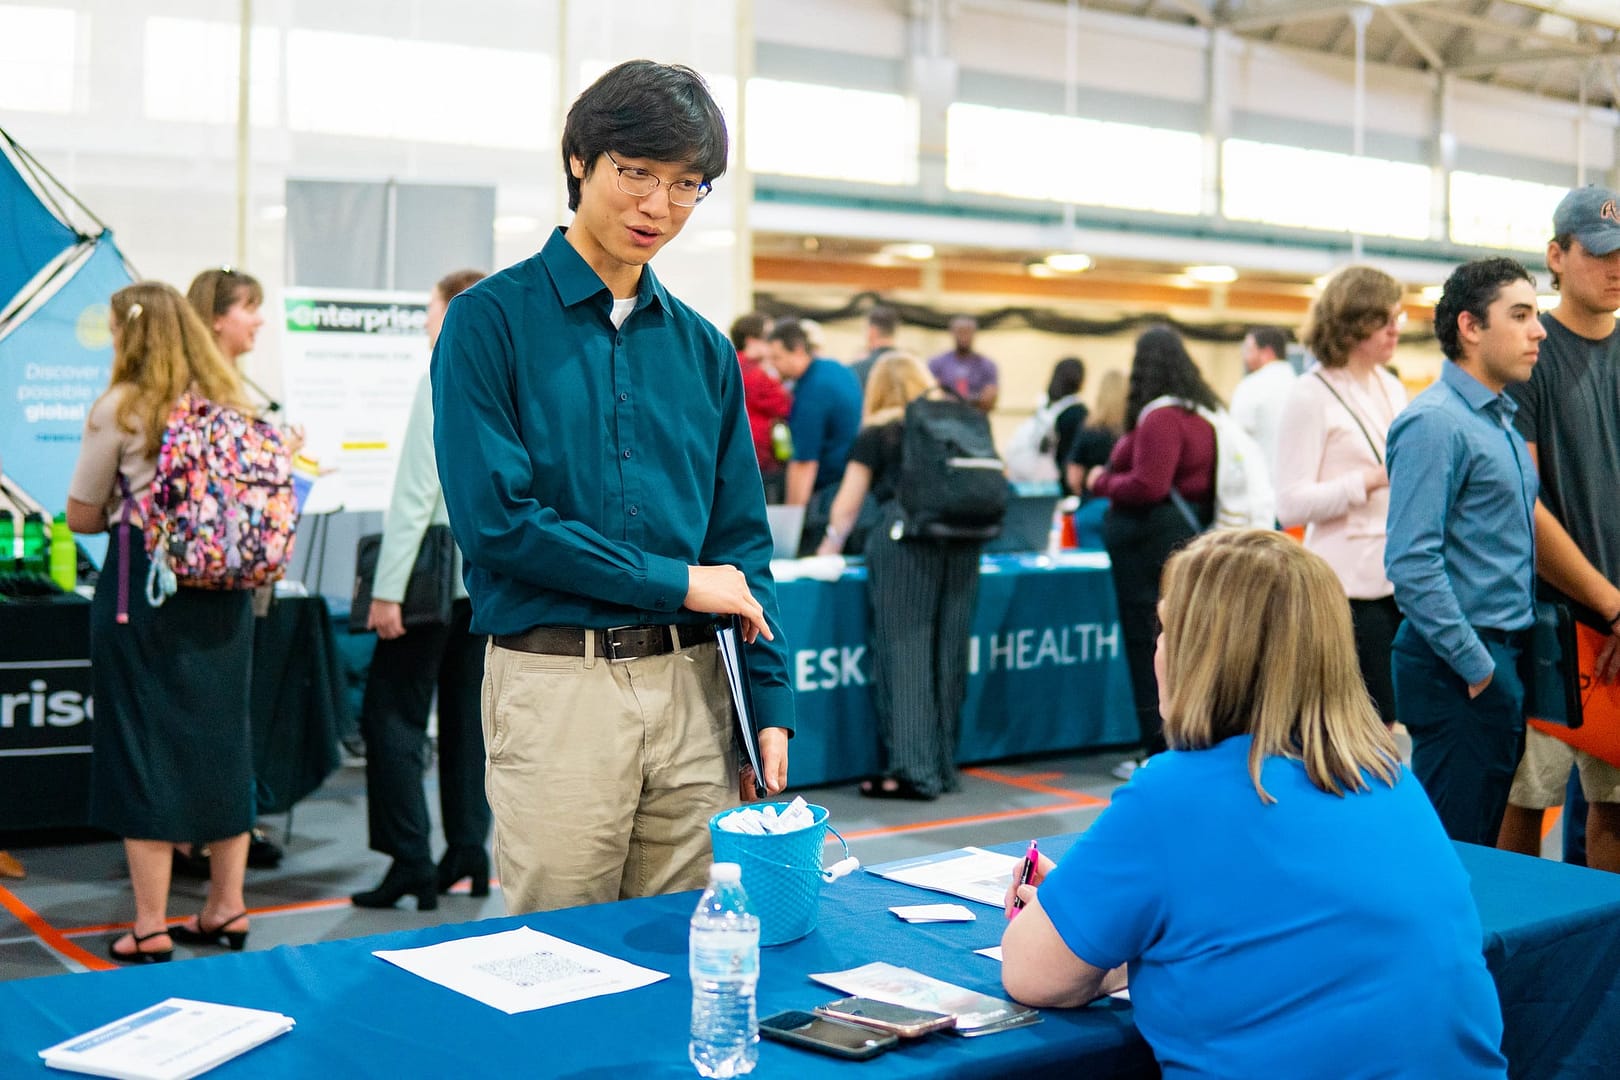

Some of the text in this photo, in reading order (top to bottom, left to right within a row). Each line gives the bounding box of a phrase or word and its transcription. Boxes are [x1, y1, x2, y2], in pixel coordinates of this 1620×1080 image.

[287, 303, 427, 332] enterprise
[26, 362, 99, 380] Discover
[18, 384, 92, 401] possible
[26, 402, 84, 423] global
[990, 622, 1119, 671] HEALTH
